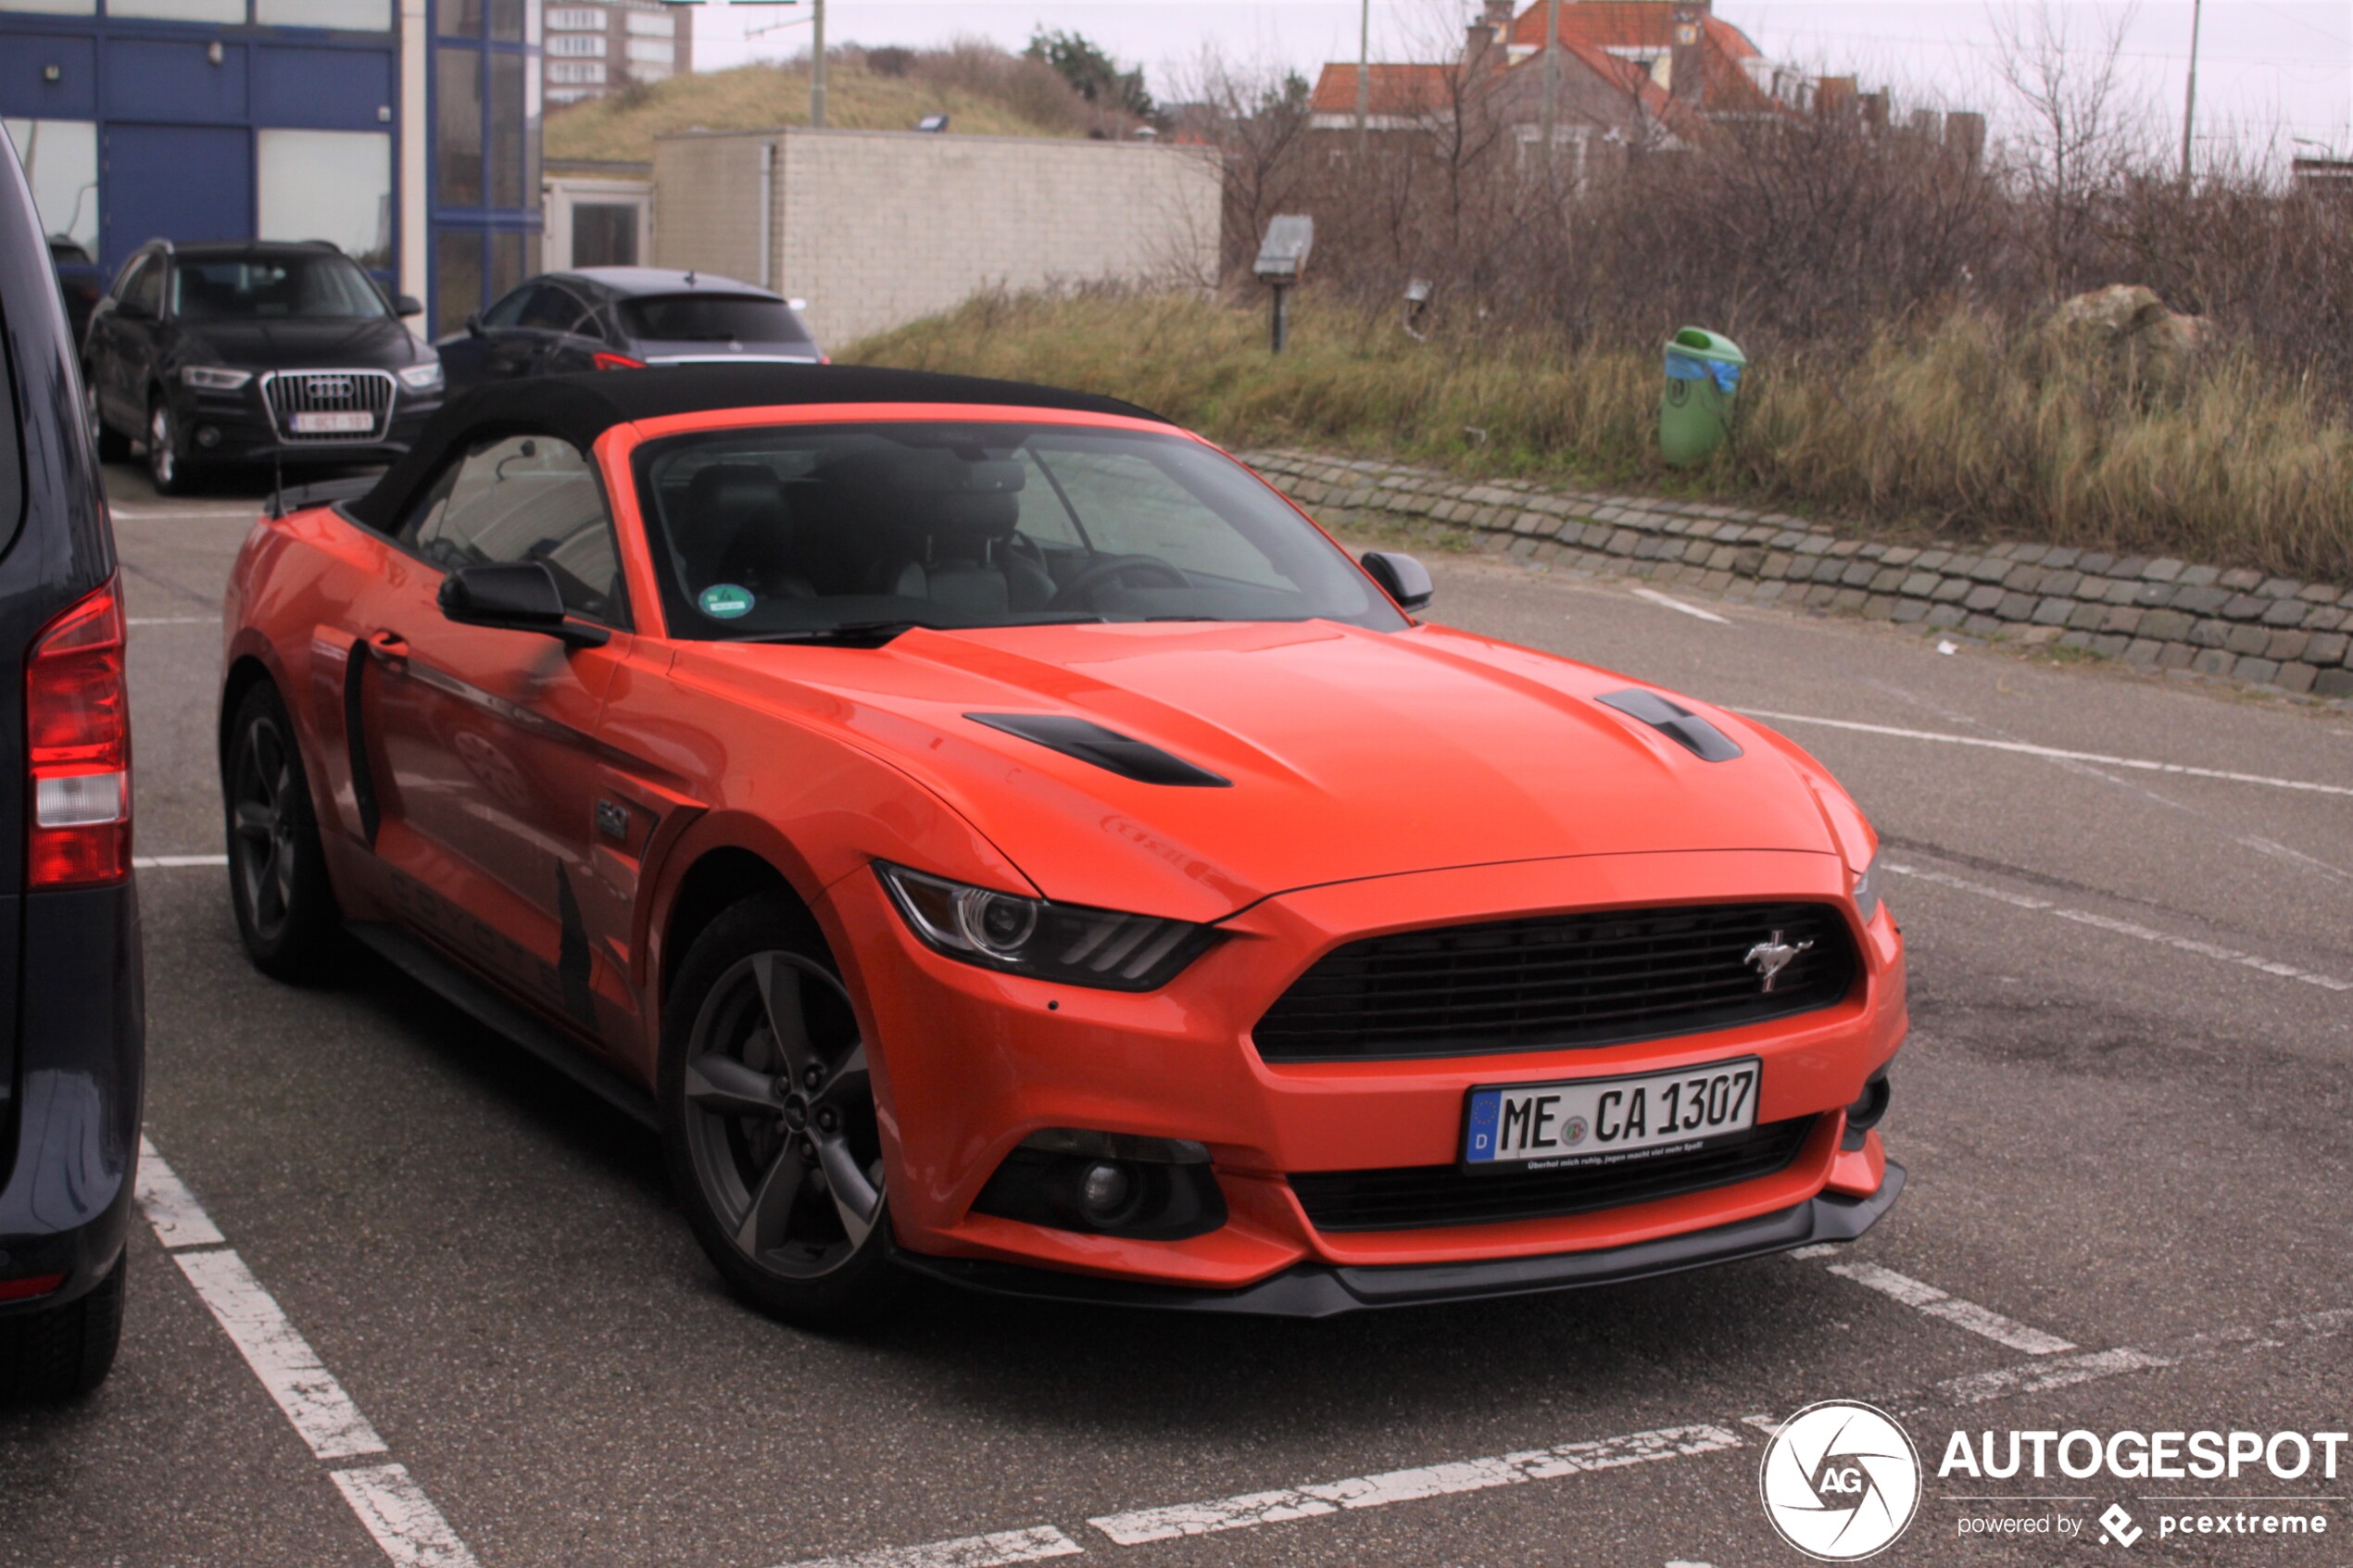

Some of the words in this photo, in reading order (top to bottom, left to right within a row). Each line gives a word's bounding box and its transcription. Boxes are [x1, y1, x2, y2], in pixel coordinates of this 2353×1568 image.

[1501, 1095, 1561, 1150] ME
[1595, 1086, 1646, 1142] CA
[1657, 1069, 1754, 1135] 1307
[1475, 1133, 1488, 1149] D
[1528, 1160, 1559, 1170] Überhol
[1560, 1157, 1579, 1167] mich
[1581, 1154, 1603, 1165] ruhig,
[1604, 1153, 1626, 1164] jagen
[1627, 1150, 1650, 1160] macht
[1650, 1148, 1665, 1157] viel
[1665, 1146, 1682, 1155] mehr
